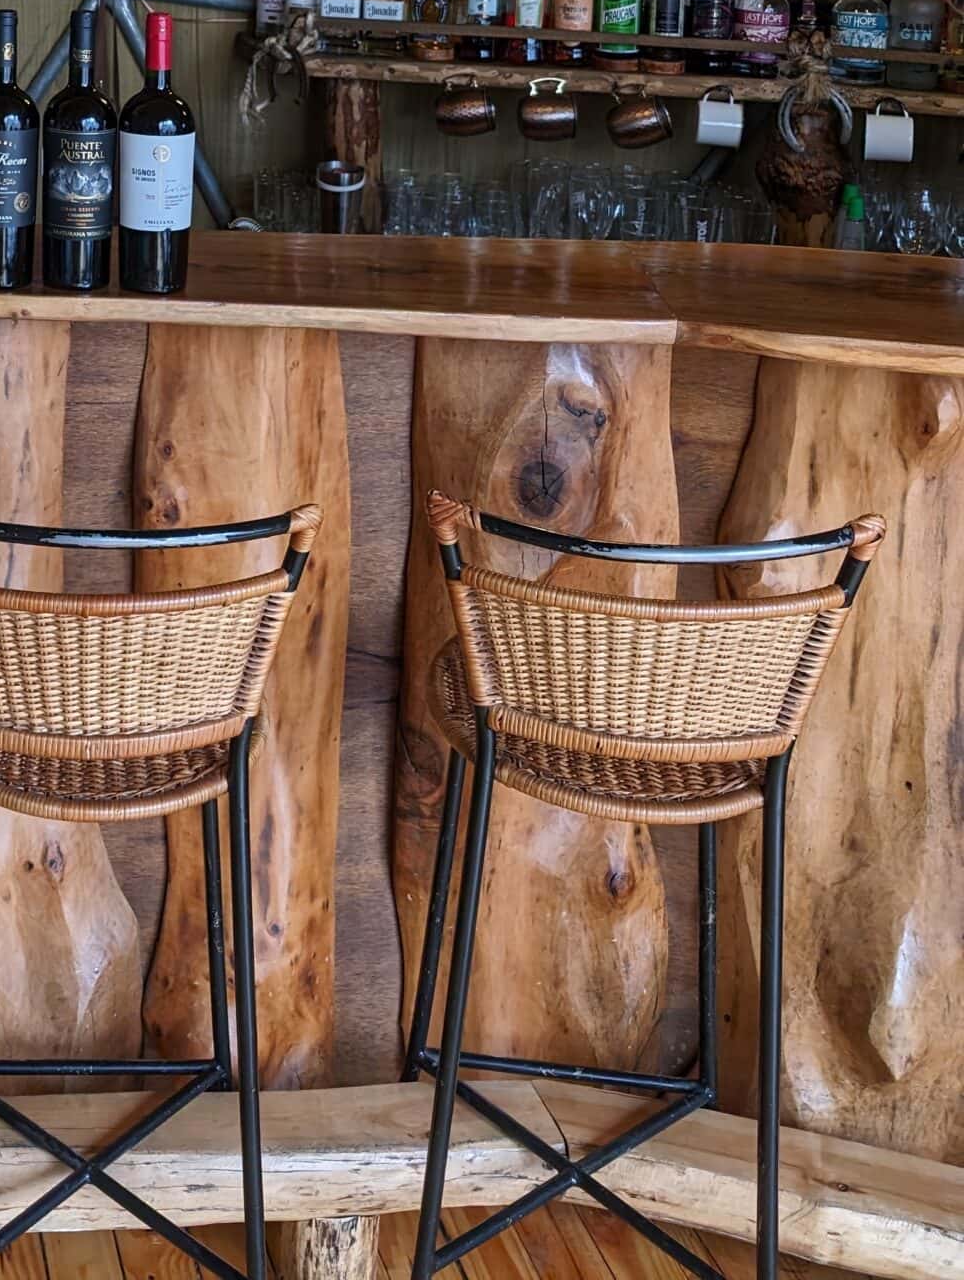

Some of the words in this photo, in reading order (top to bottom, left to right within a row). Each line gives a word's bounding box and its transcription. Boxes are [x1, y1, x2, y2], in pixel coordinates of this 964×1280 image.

[745, 13, 761, 24] LAST
[762, 14, 783, 25] HOPE
[854, 16, 877, 27] HOPE
[900, 29, 932, 41] GIN
[61, 138, 102, 151] PUENTE
[60, 150, 105, 162] AUSTRAL
